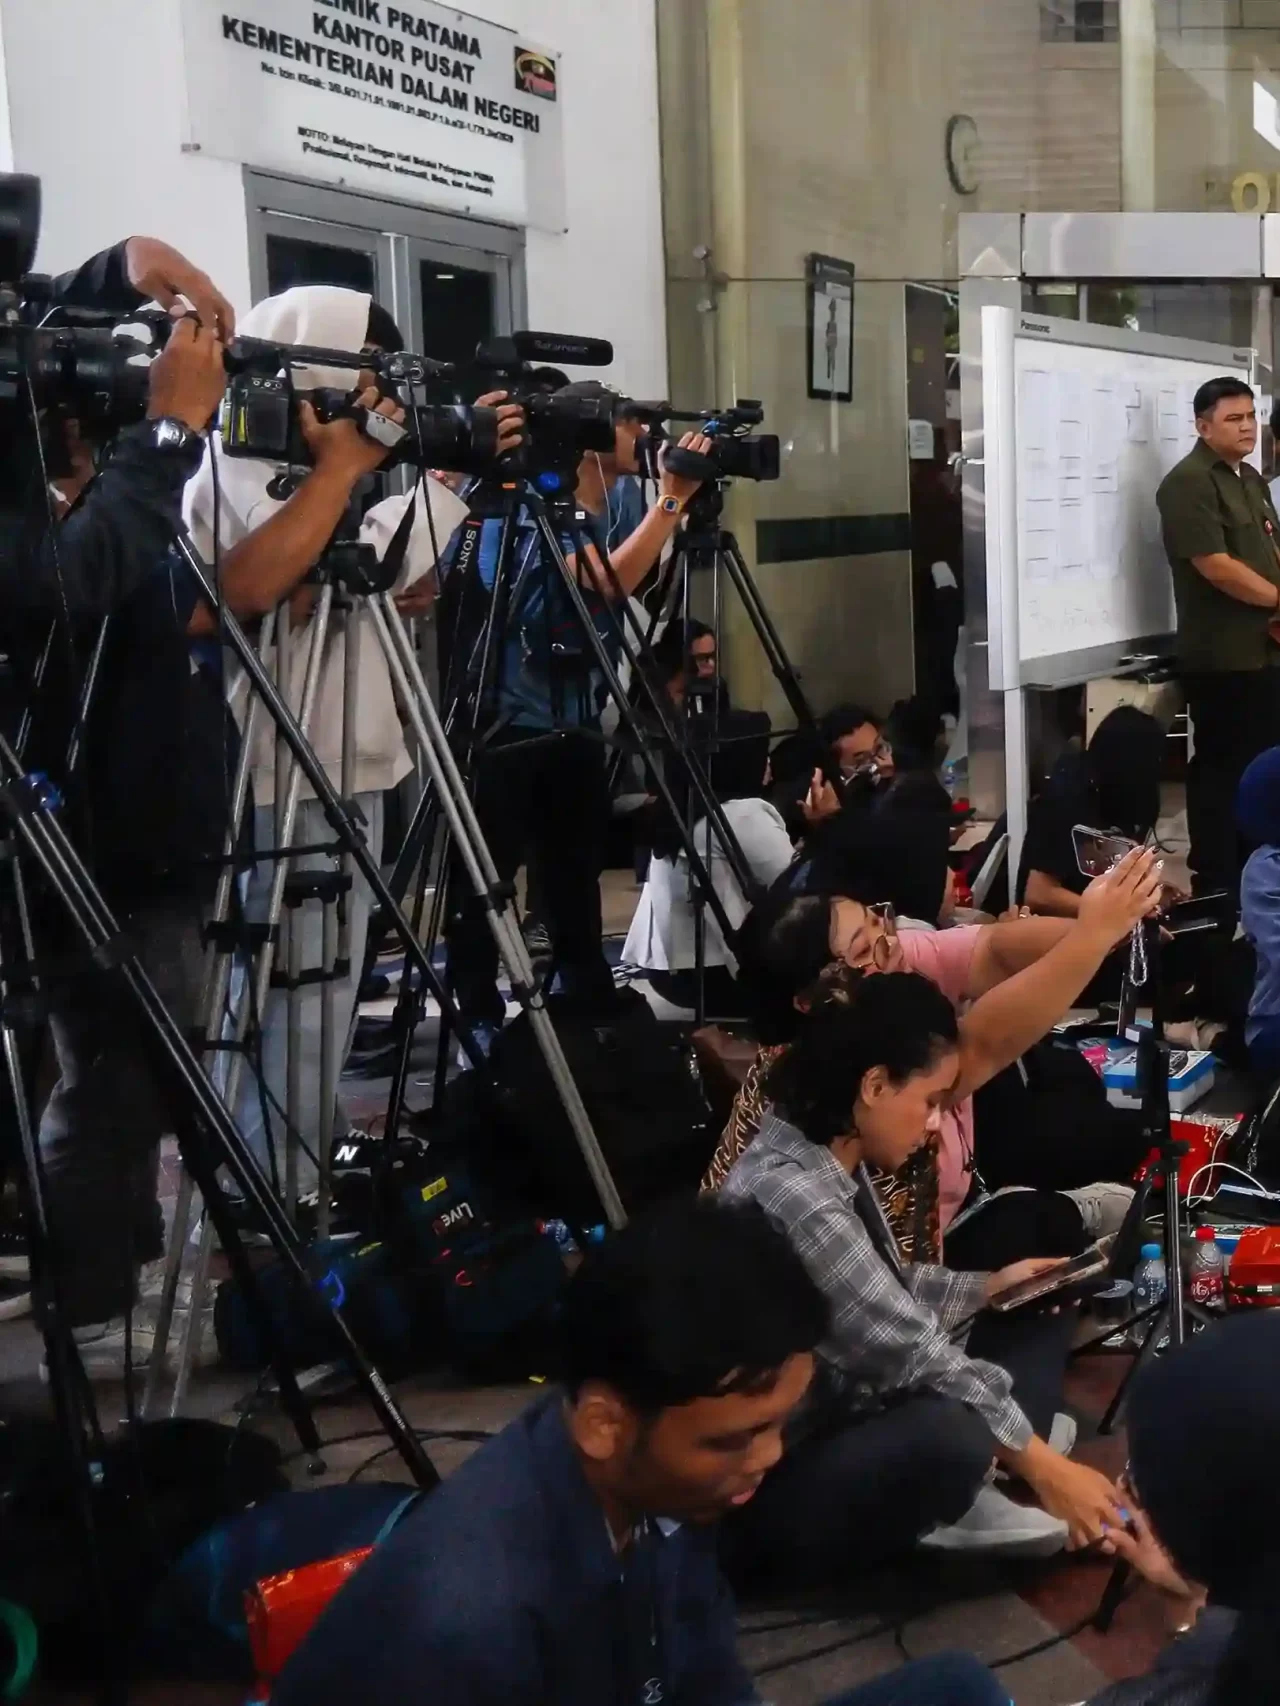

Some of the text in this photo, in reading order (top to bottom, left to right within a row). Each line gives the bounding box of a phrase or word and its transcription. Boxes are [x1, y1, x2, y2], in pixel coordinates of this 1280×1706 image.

[313, 12, 475, 84] KANTOR PUSAT
[387, 6, 482, 59] PRATAMA
[222, 14, 539, 133] KEMENTERIAN DALAM NEGERI
[456, 529, 477, 574] SONY
